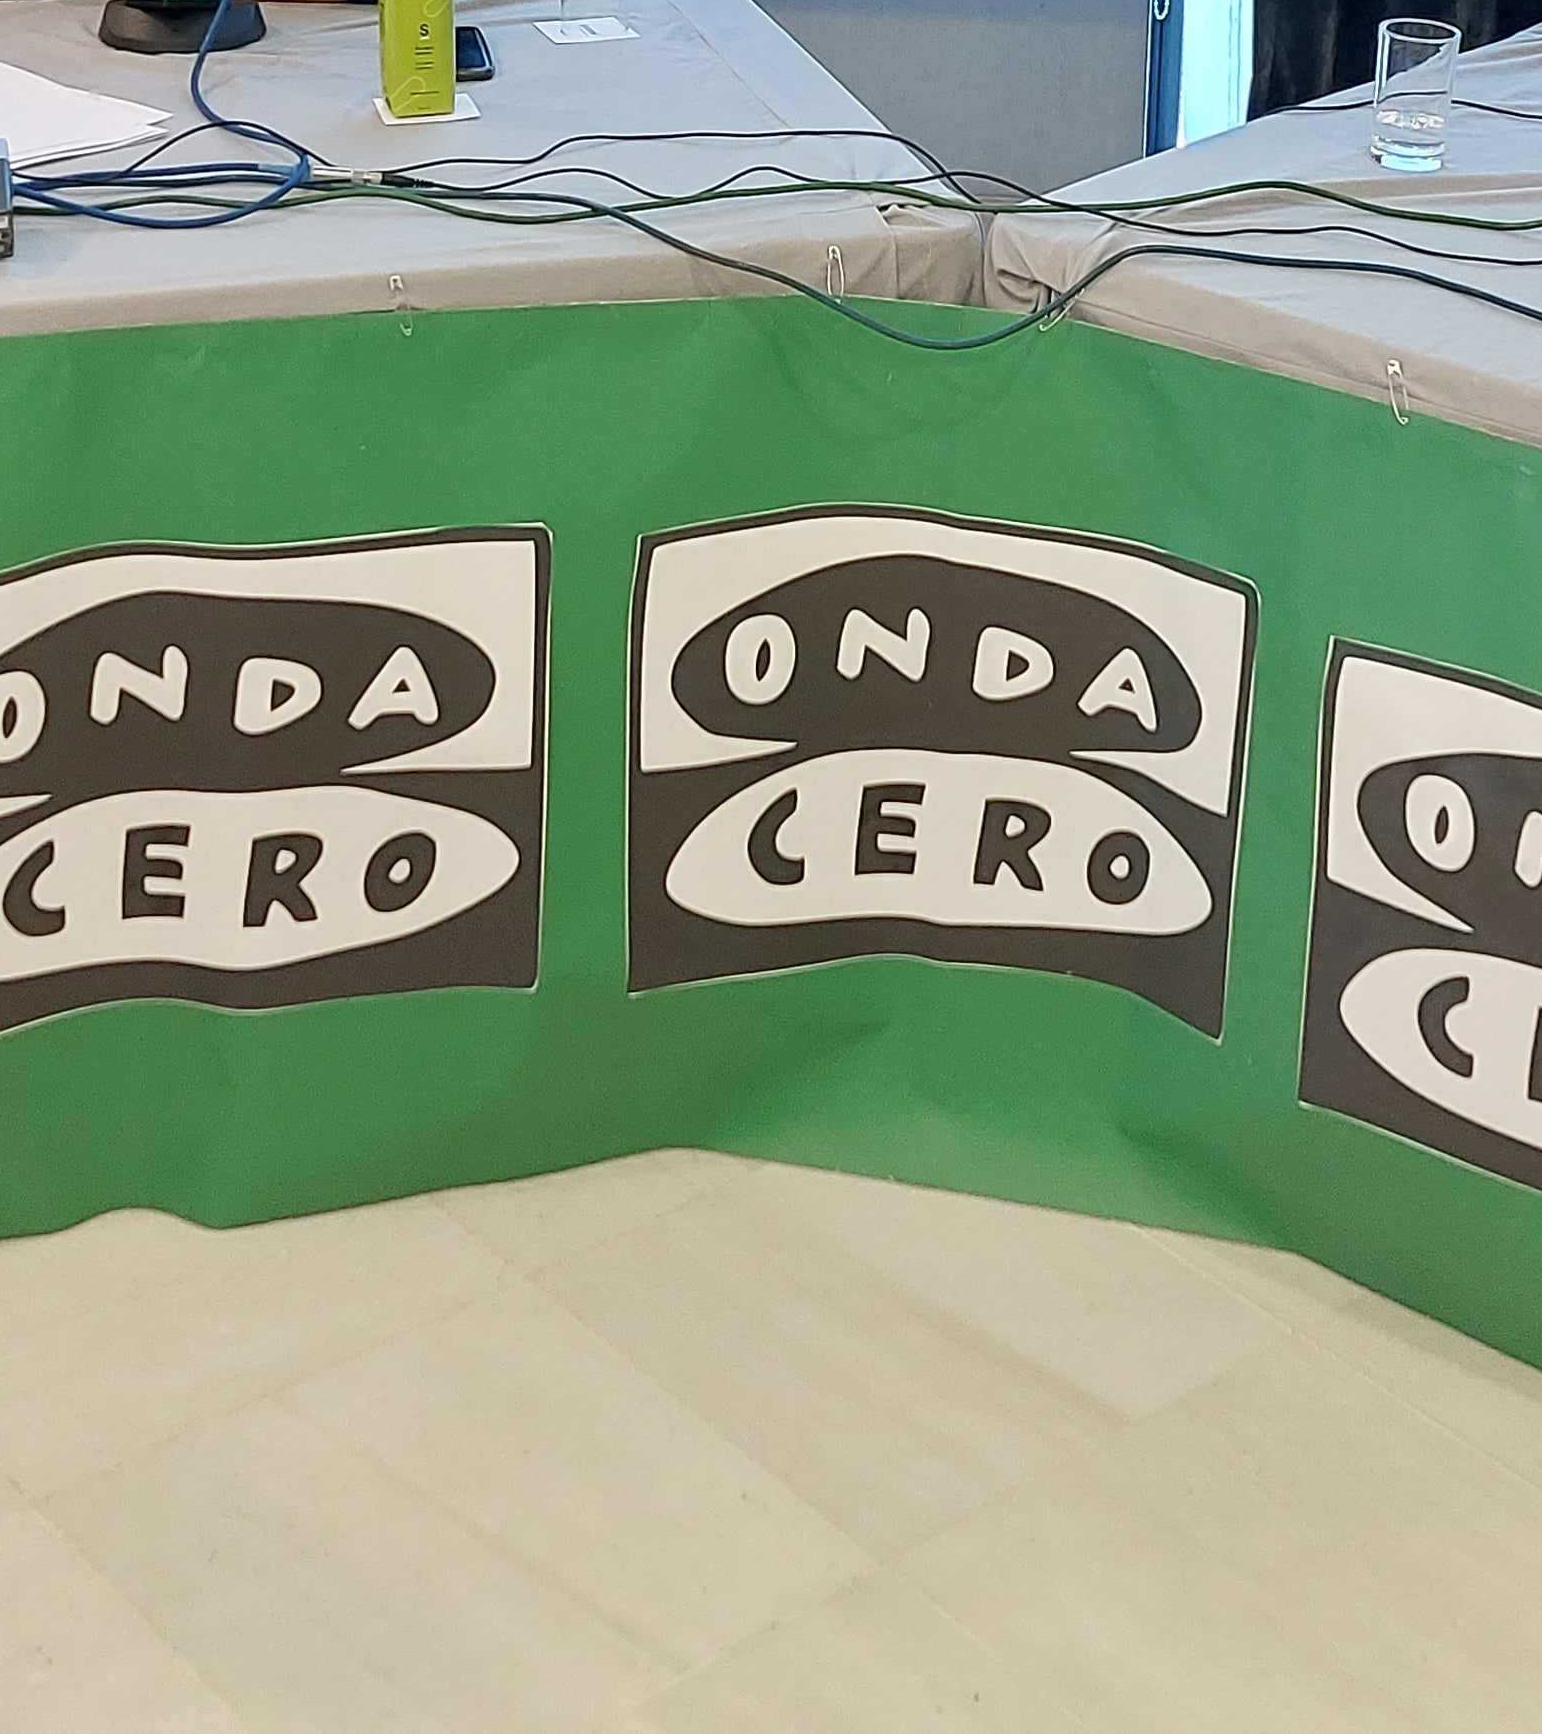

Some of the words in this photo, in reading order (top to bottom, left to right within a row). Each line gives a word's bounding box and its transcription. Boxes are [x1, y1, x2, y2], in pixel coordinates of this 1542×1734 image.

[419, 23, 430, 37] S
[725, 607, 1157, 732] ONDA
[3, 823, 437, 936] CERO
[748, 782, 1150, 906] CERO
